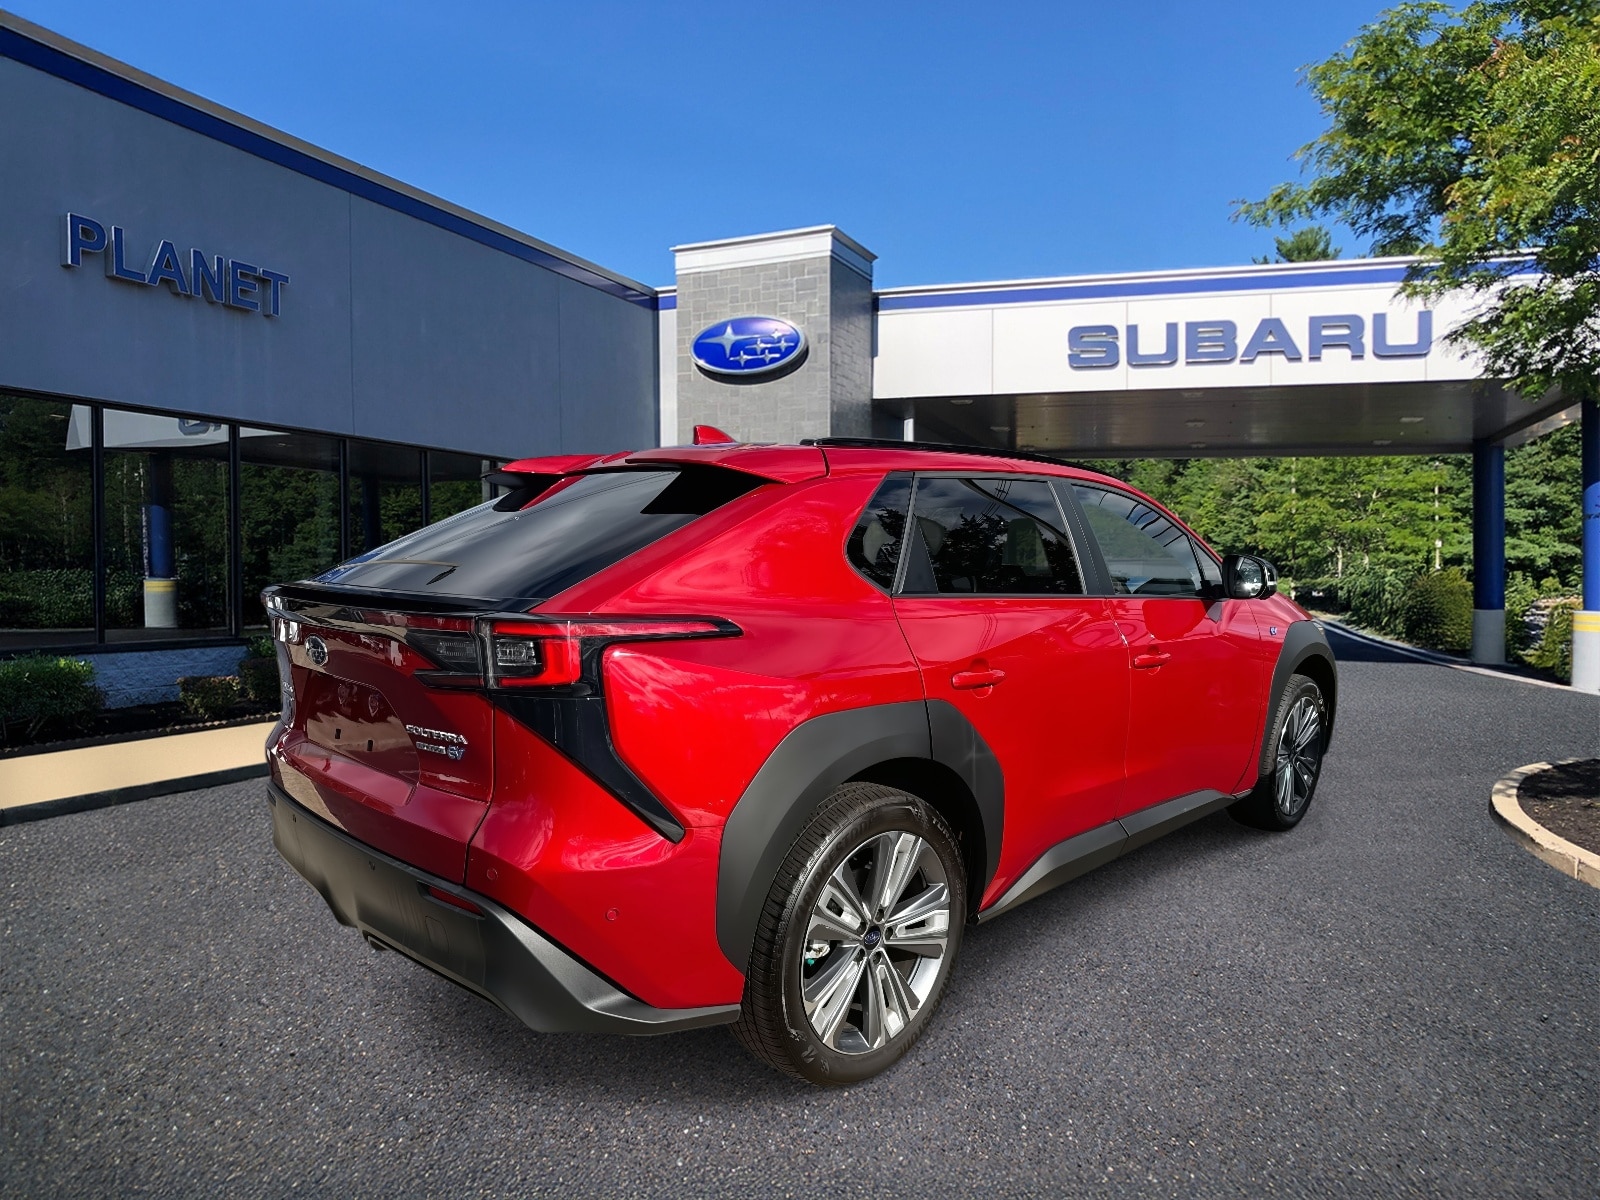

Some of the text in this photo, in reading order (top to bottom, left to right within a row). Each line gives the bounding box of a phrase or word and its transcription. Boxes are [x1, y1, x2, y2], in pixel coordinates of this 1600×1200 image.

[63, 212, 290, 317] PLANET
[1067, 310, 1433, 369] SUBARU
[406, 724, 468, 745] SOLTERRA
